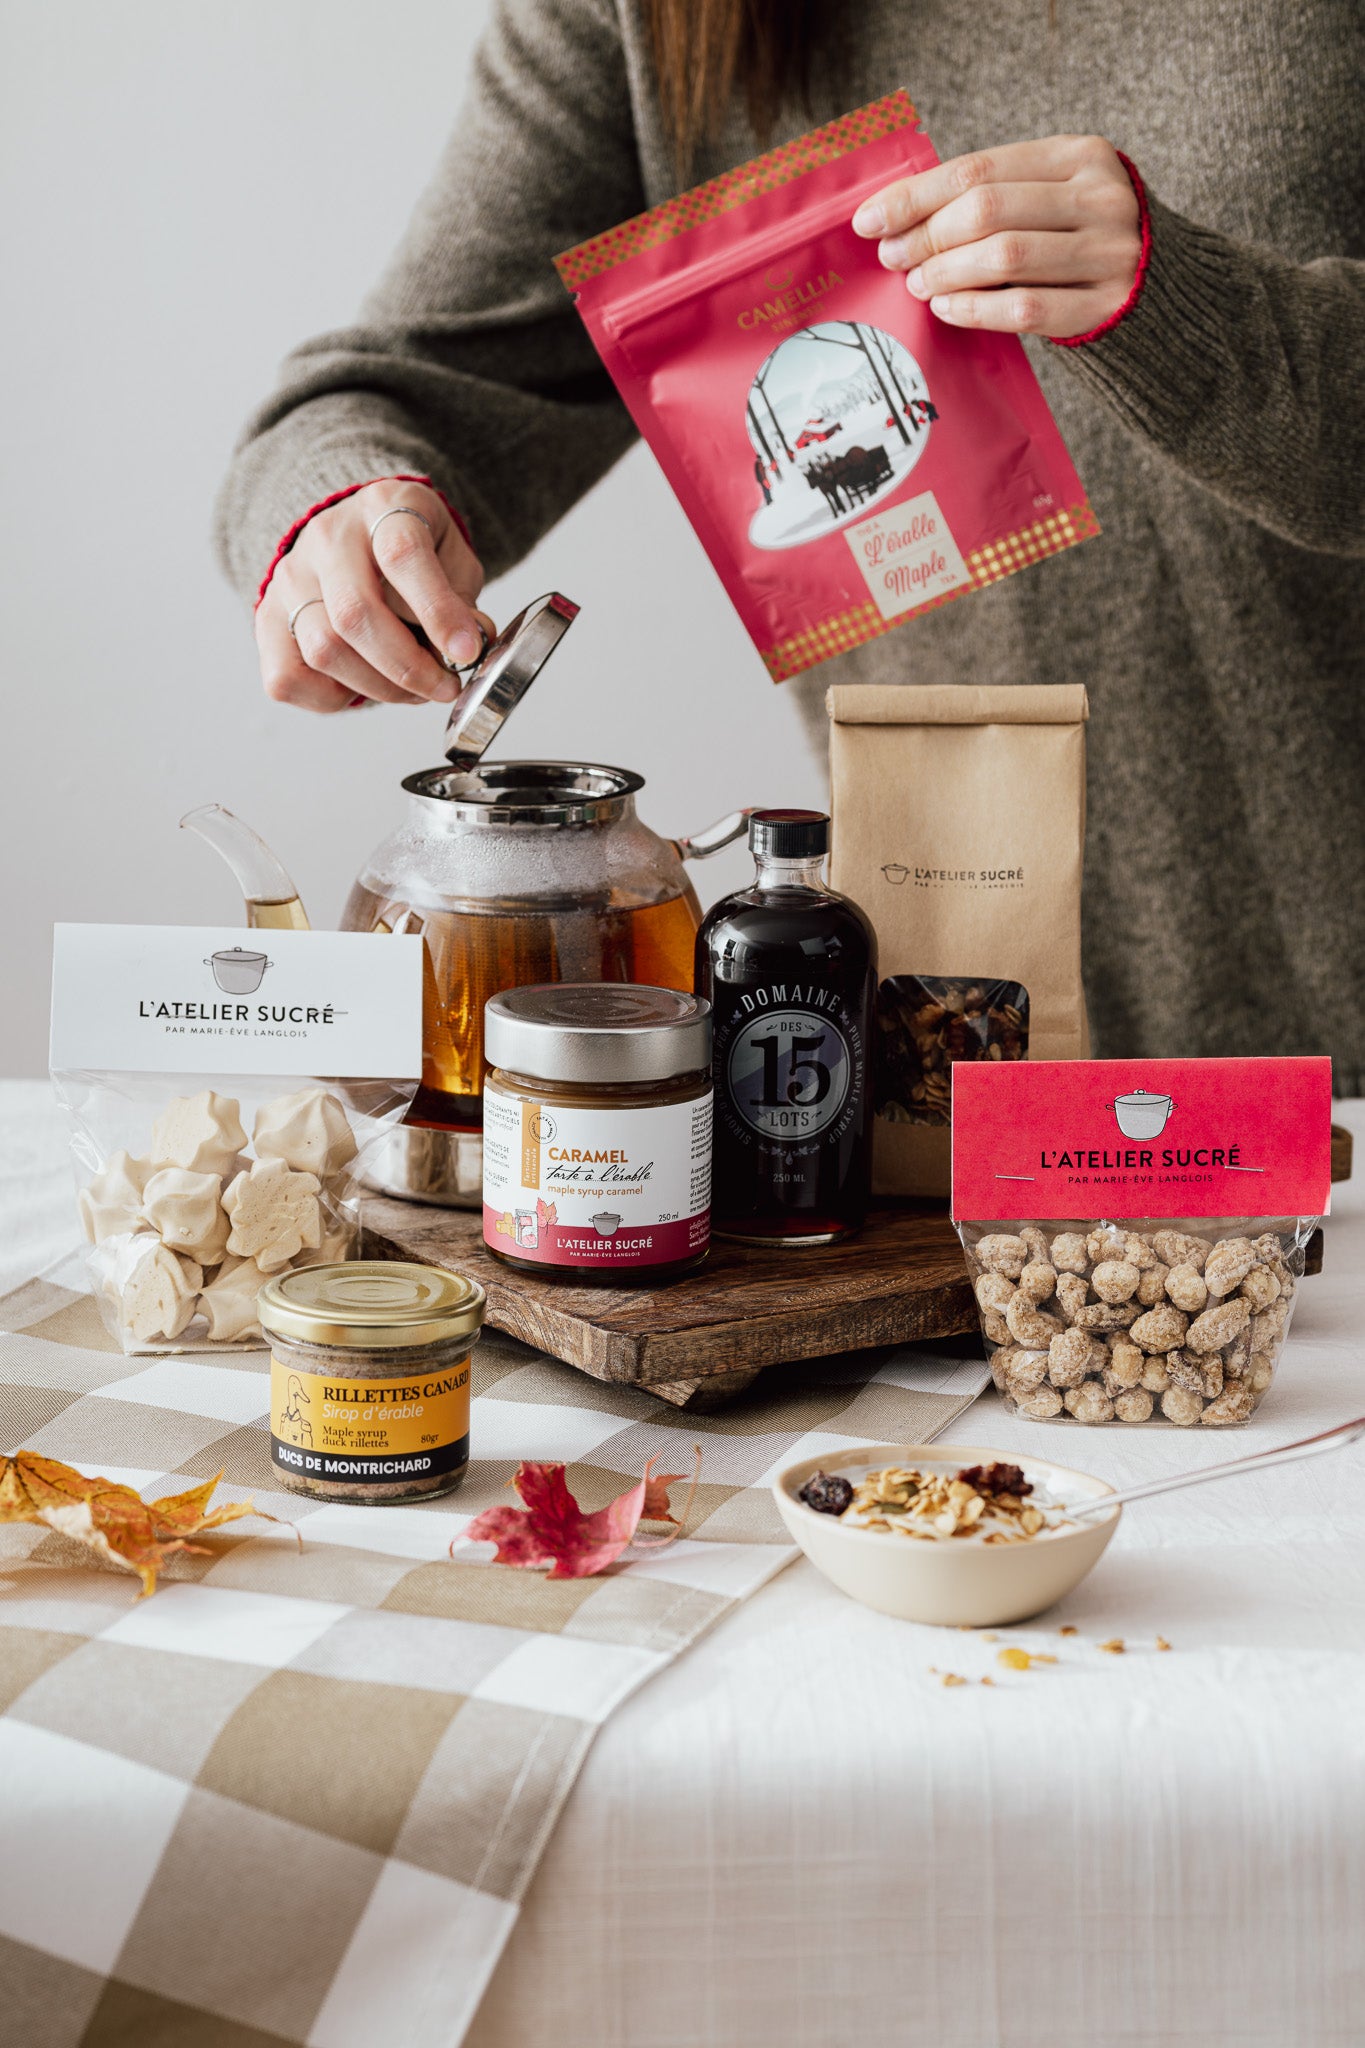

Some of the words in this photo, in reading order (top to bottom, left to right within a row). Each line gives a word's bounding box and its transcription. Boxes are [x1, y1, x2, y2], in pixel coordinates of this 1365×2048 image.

[737, 270, 845, 331] CAMELLIA
[884, 550, 946, 597] Maple
[915, 868, 976, 881] L'ATELIER
[980, 867, 1024, 881] SUCRÉ
[740, 984, 841, 1013] DOMAINE
[139, 1001, 249, 1021] L'ATELIER
[258, 1004, 334, 1024] SUCRÉ
[165, 1026, 185, 1034] PAR
[254, 1029, 308, 1038] LANGLOIS
[780, 1022, 802, 1032] DES
[848, 1025, 861, 1058] PURE
[750, 1035, 831, 1108] 15
[854, 1060, 864, 1105] MAPLE
[770, 1111, 809, 1127] LOTS
[828, 1107, 856, 1145] SYRUP
[548, 1147, 629, 1164] CARAMEL
[1041, 1150, 1154, 1169] L'ATELIER
[1162, 1143, 1241, 1167] SUCRÉ
[546, 1164, 583, 1181] tarte
[773, 1173, 791, 1183] 250
[793, 1174, 806, 1183] ML
[1068, 1176, 1089, 1184] PAR
[1158, 1174, 1213, 1183] LANGLOIS
[548, 1184, 575, 1197] maple
[577, 1188, 604, 1199] syrup
[606, 1184, 643, 1196] caramel
[659, 1213, 671, 1222] 250
[672, 1212, 679, 1220] ml
[557, 1238, 611, 1250] L'ATELIER
[616, 1236, 653, 1250] SUCRÉ
[323, 1386, 420, 1403] RILLETTES
[423, 1369, 469, 1398] CANARD
[321, 1404, 359, 1423] Sirop
[362, 1404, 424, 1421] d'érable
[322, 1425, 354, 1438] Maple
[356, 1427, 387, 1439] syrup
[420, 1433, 439, 1445] 80gr
[322, 1437, 347, 1447] duck
[350, 1437, 389, 1448] rillettes
[278, 1446, 303, 1467] DUCS
[305, 1456, 321, 1471] DE
[325, 1458, 431, 1475] MONTRICHARD
